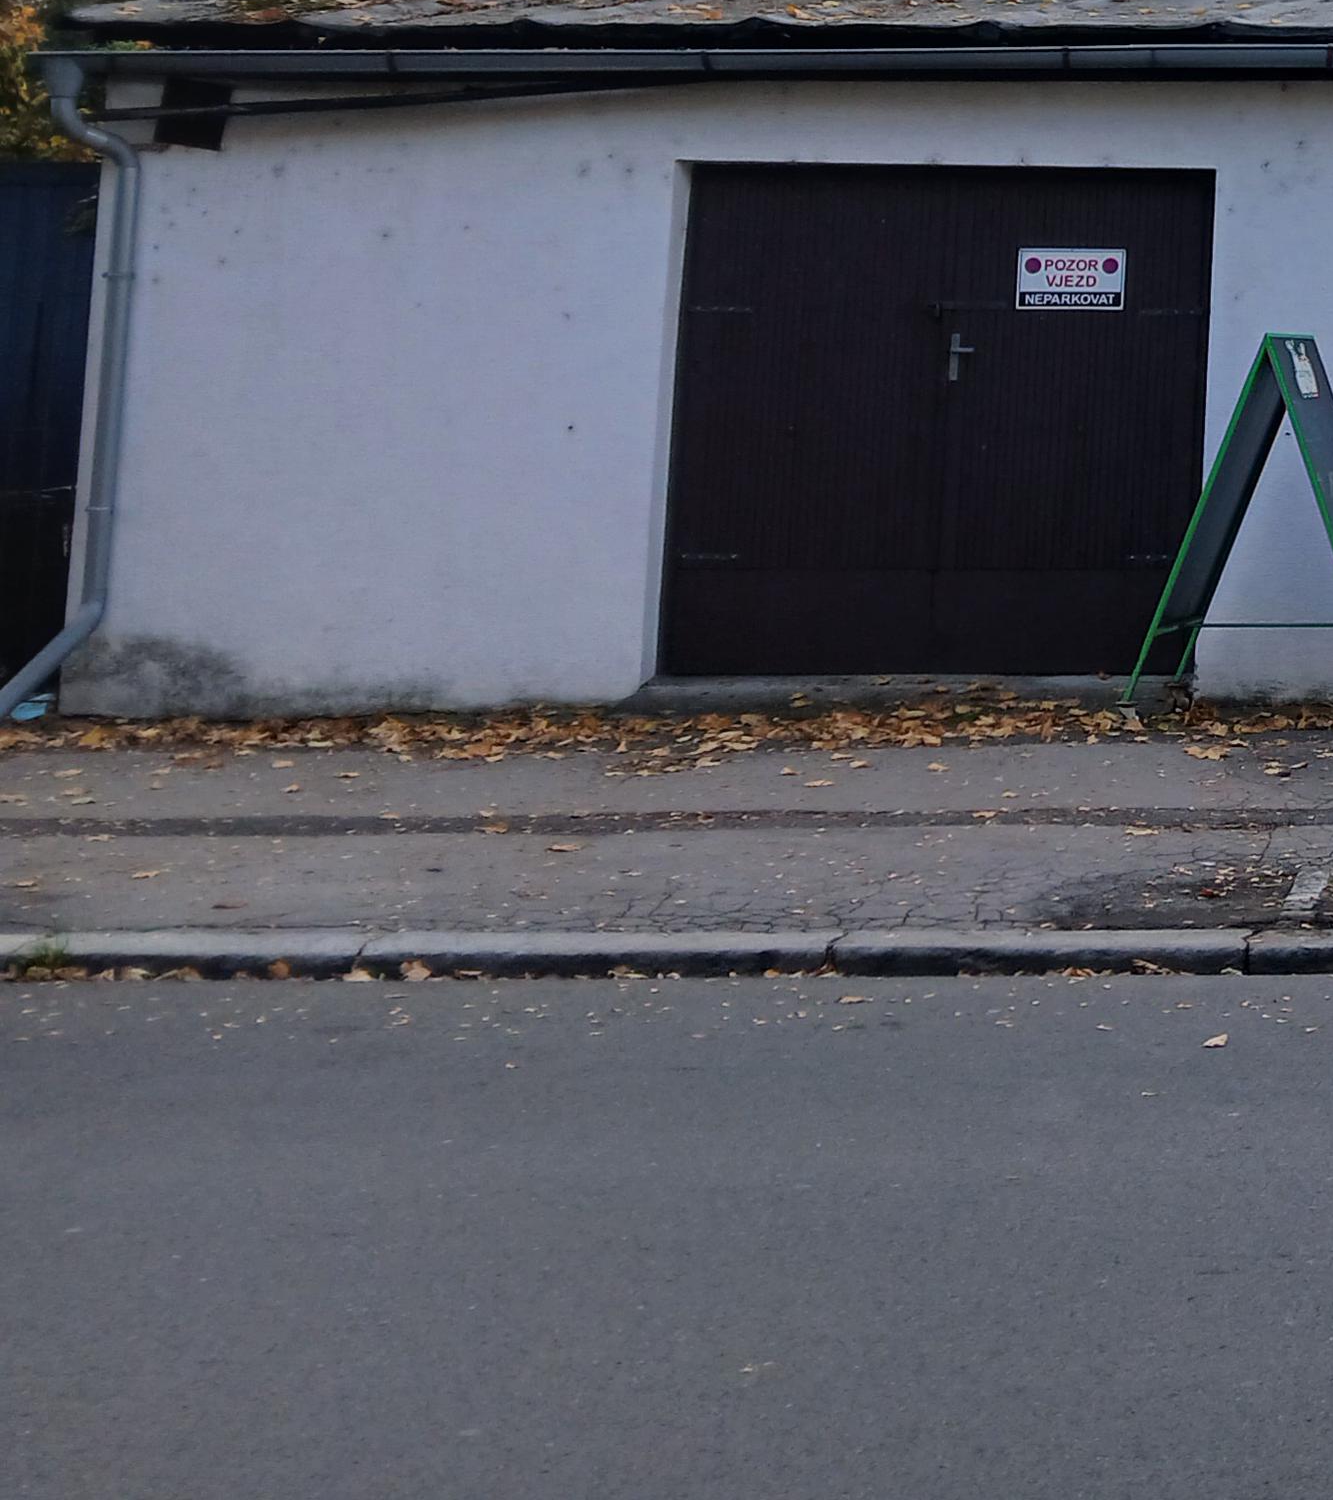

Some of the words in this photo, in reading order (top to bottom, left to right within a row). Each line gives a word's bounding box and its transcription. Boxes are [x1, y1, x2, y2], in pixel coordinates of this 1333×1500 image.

[1045, 259, 1098, 271] POZOR
[1046, 275, 1097, 287] VJEZD
[1025, 293, 1115, 305] NEPARKOVAT
